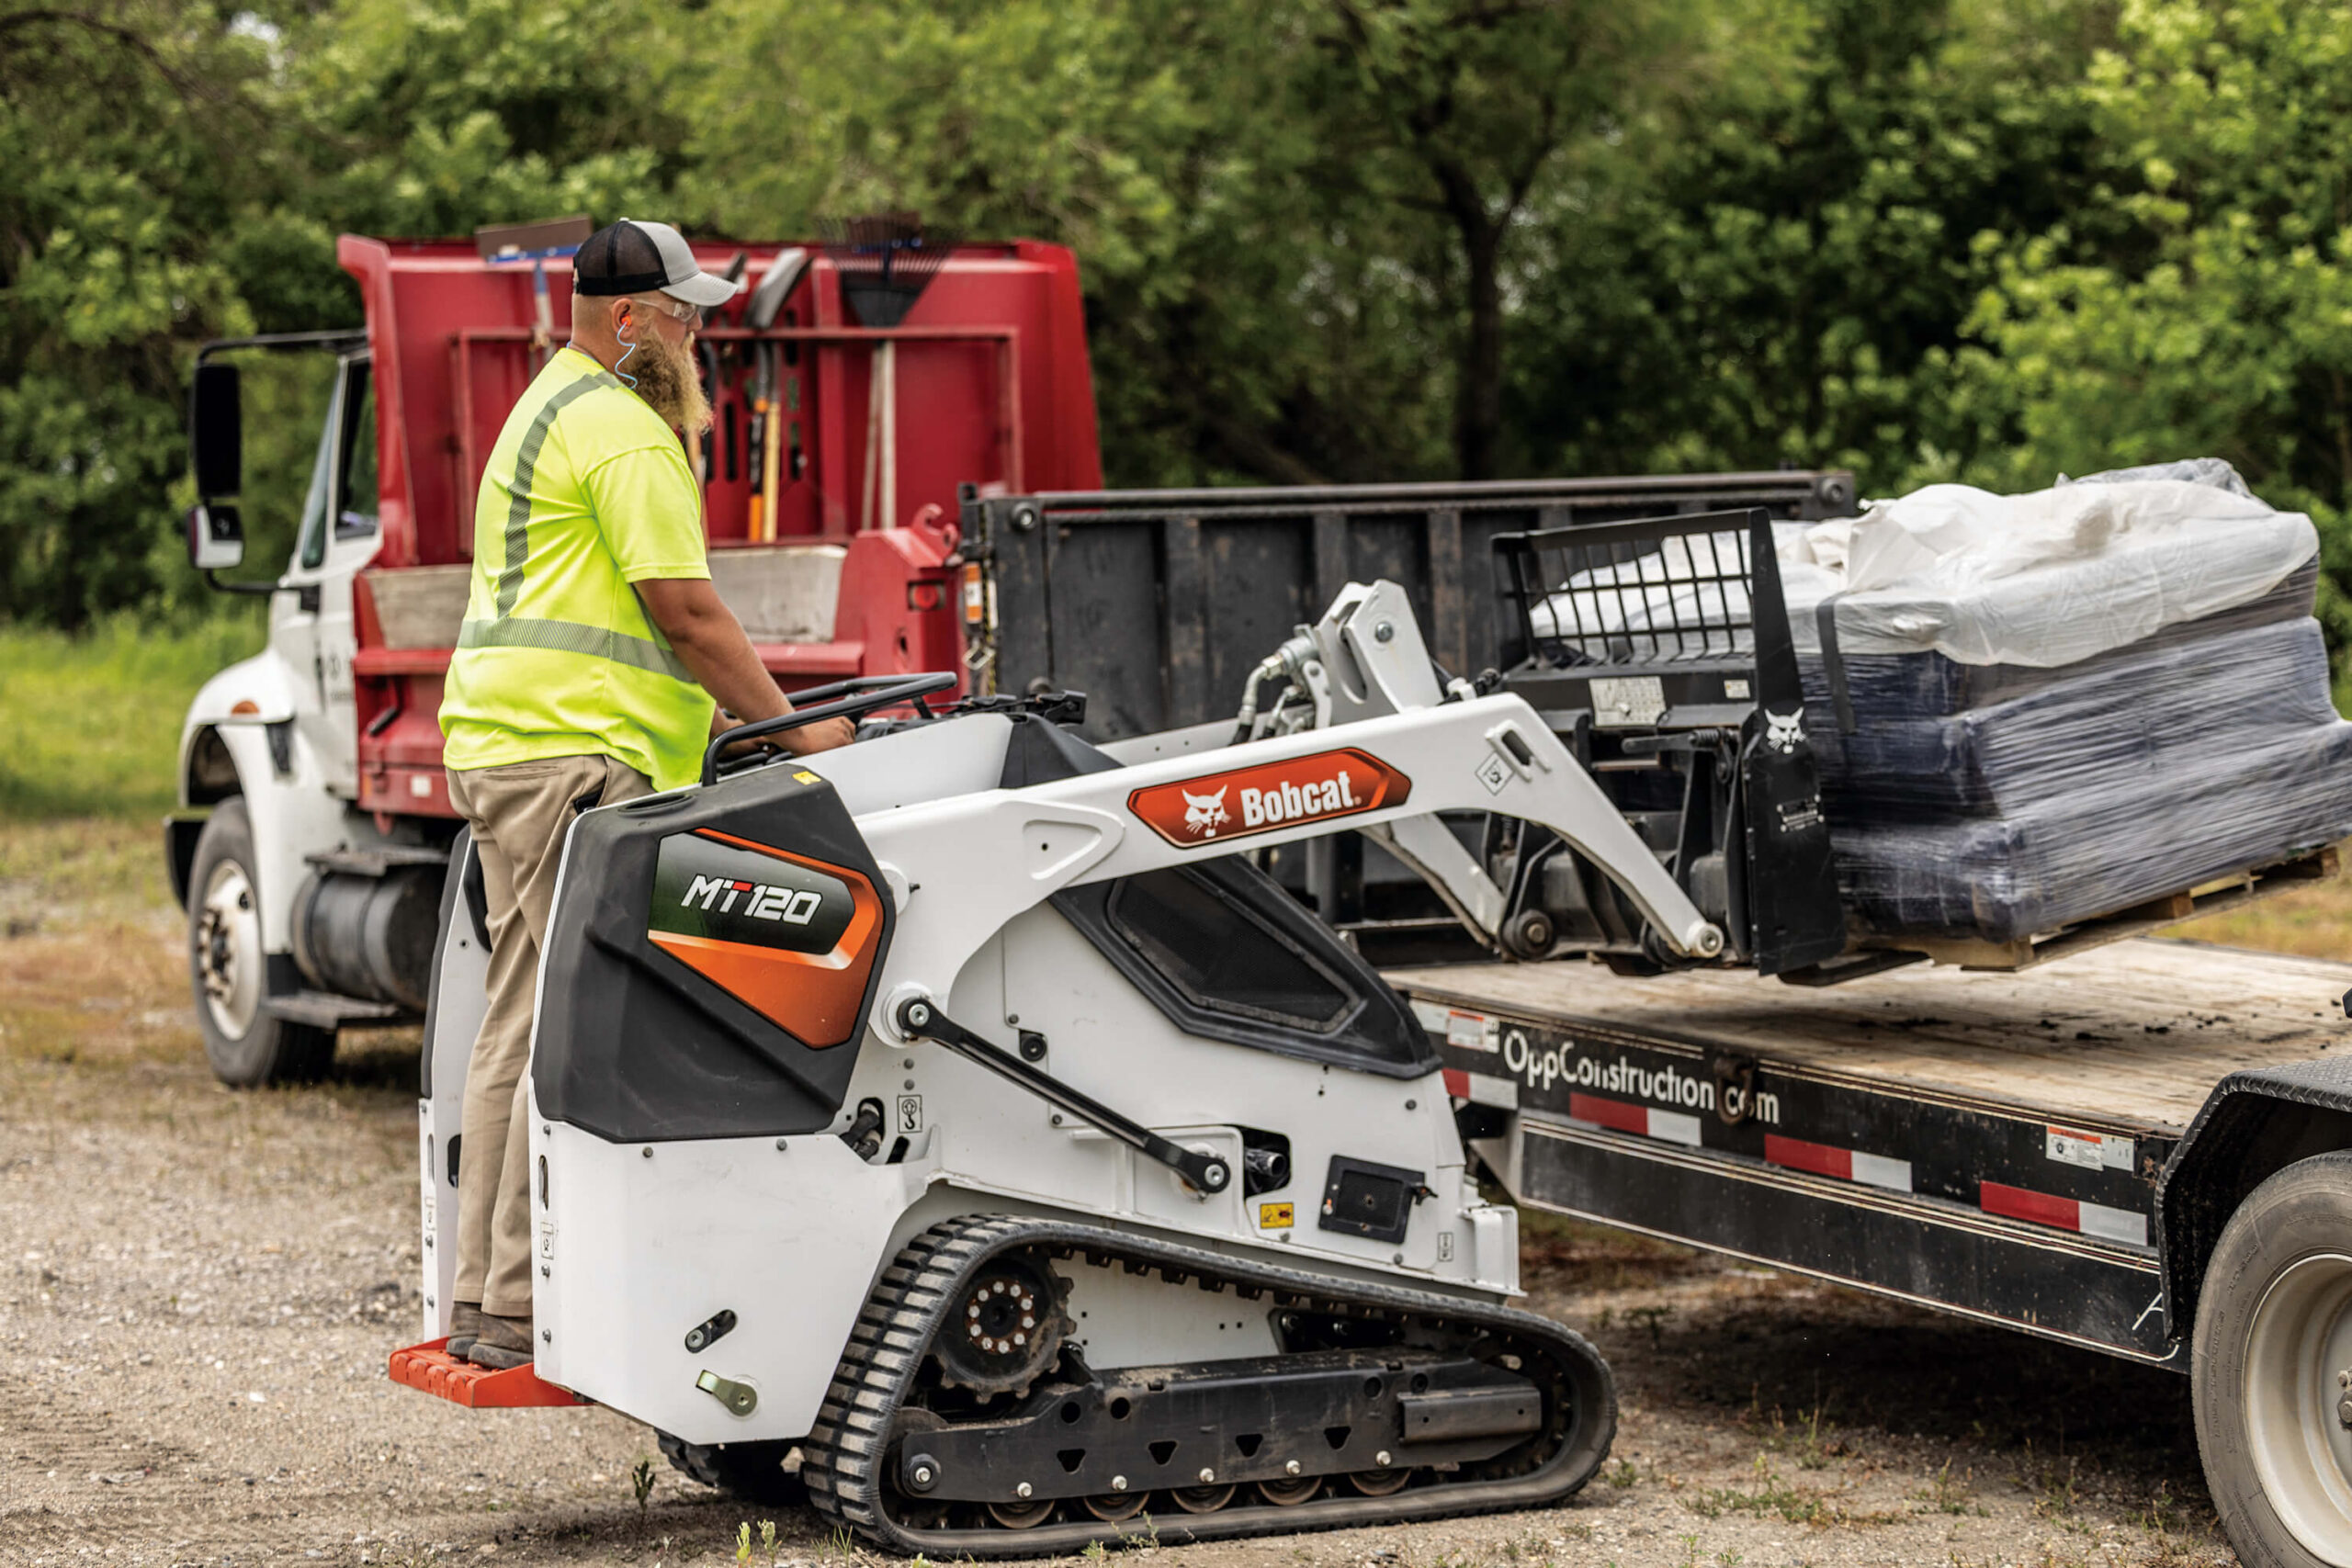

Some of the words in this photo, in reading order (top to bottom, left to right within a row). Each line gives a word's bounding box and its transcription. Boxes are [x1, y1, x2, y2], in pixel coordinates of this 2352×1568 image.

[1240, 771, 1354, 827] Bobcat
[681, 874, 822, 925] MT120
[1504, 1030, 1780, 1123] OppConstructioncom
